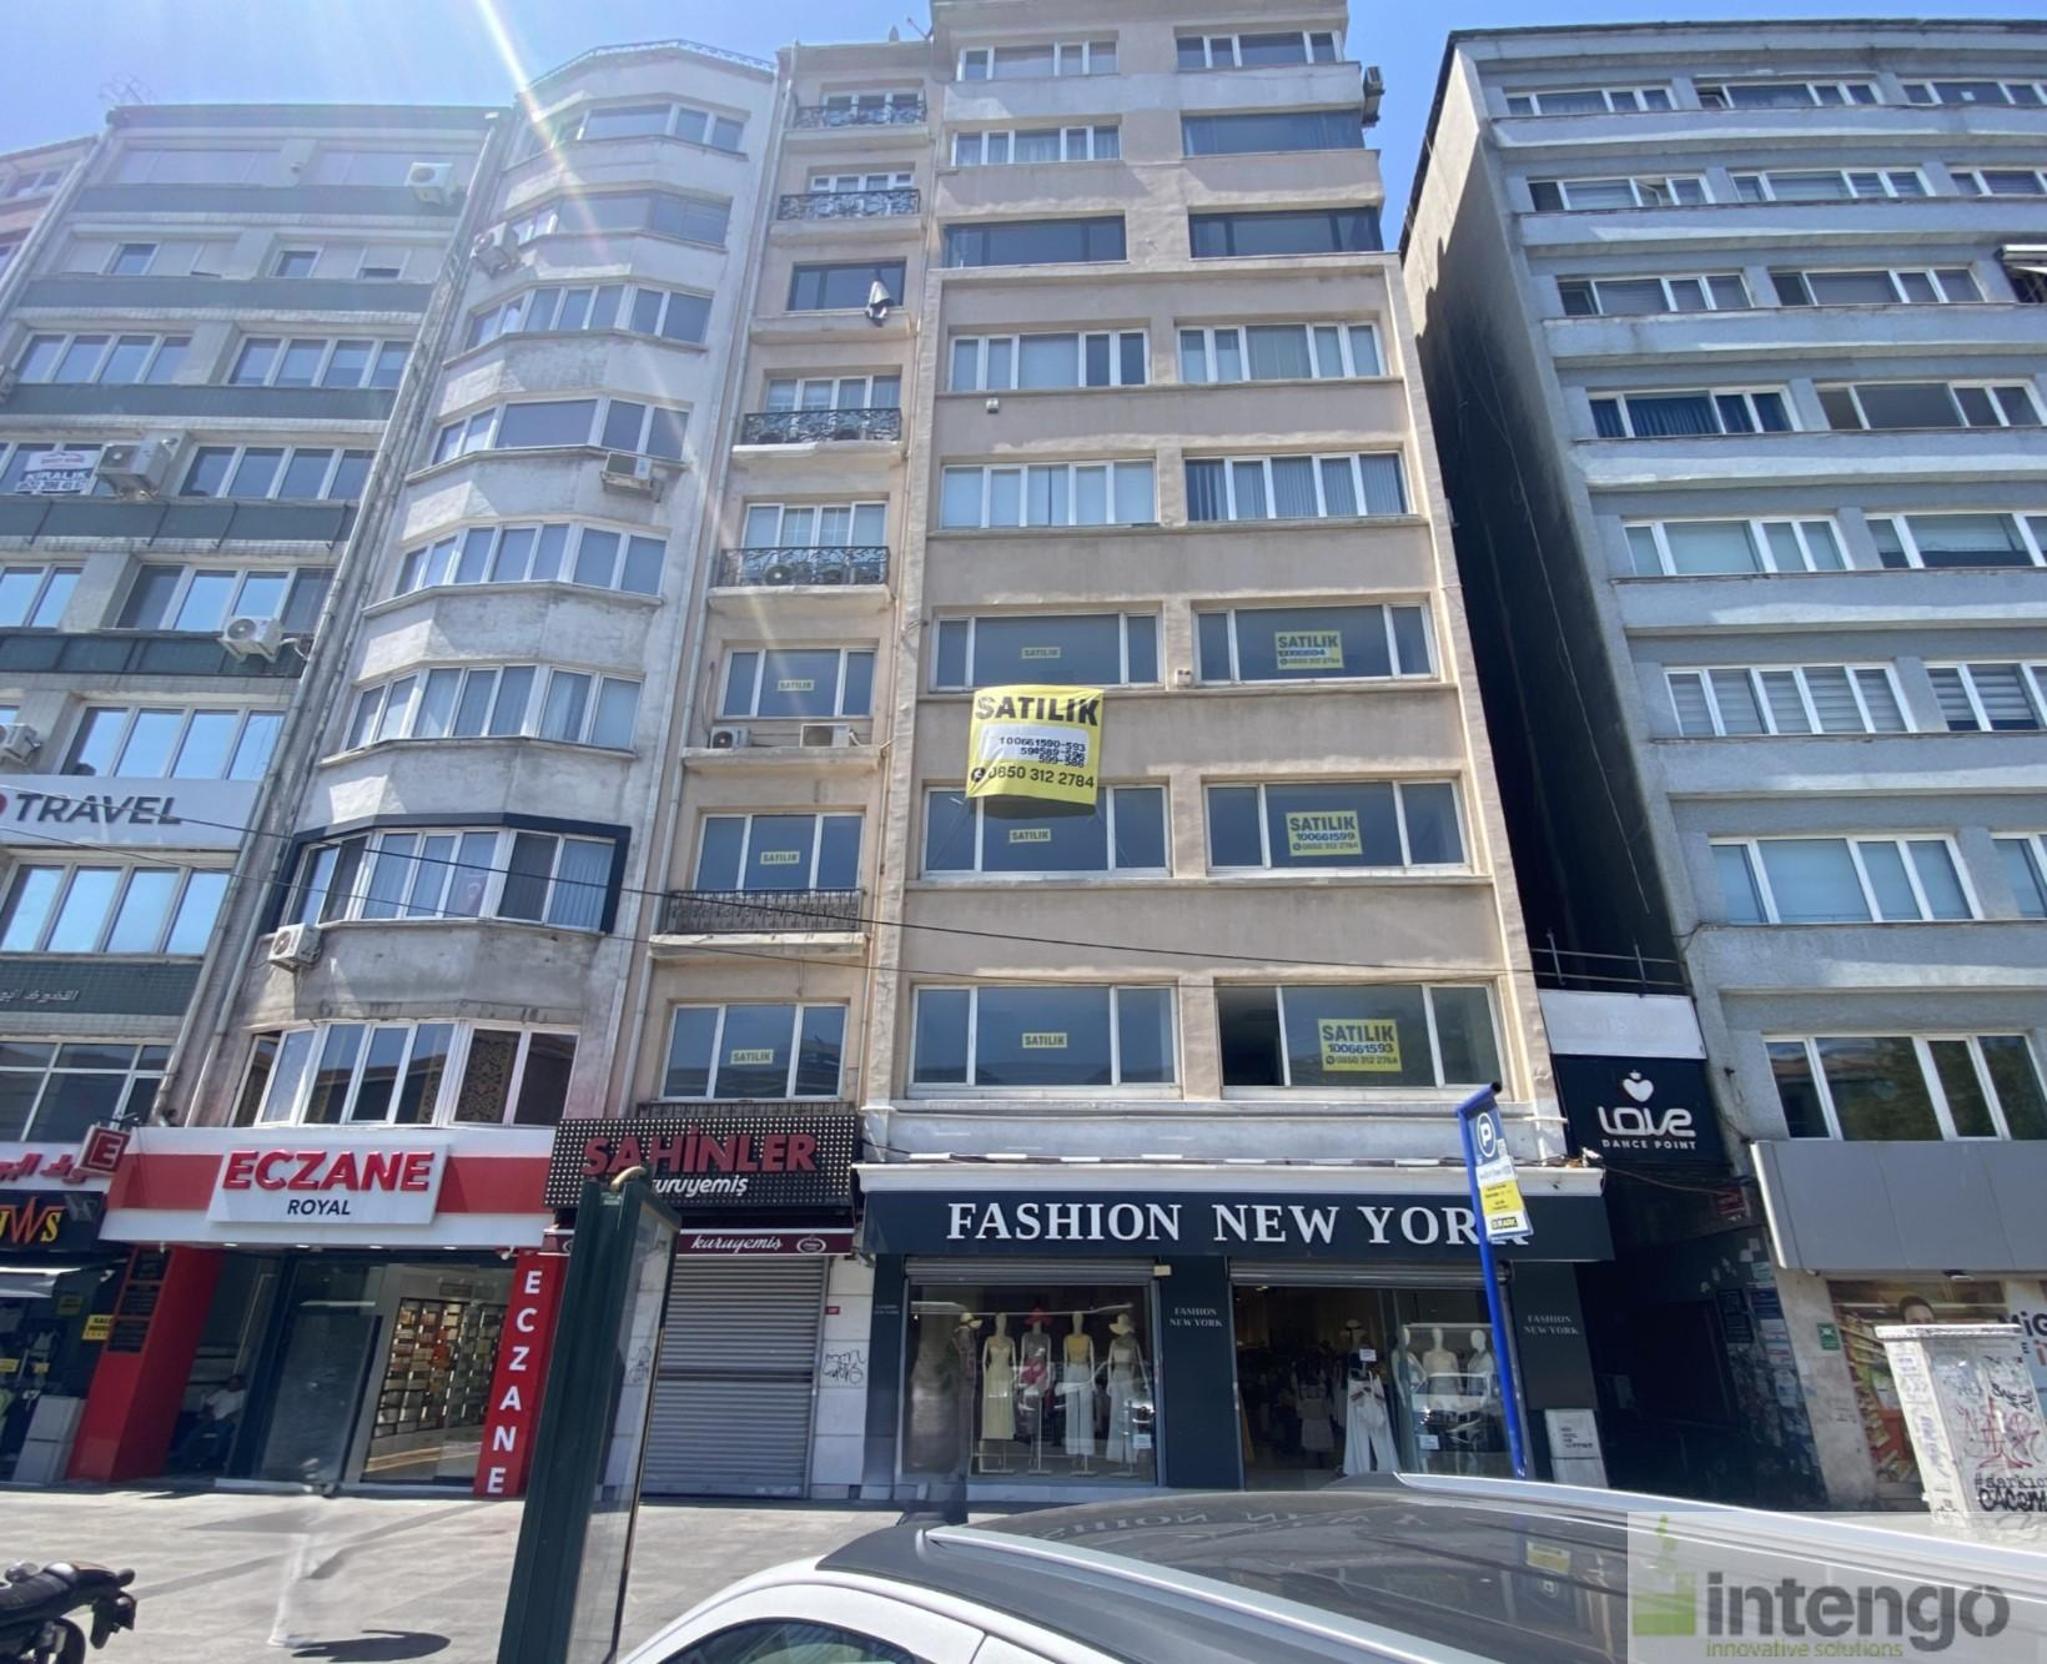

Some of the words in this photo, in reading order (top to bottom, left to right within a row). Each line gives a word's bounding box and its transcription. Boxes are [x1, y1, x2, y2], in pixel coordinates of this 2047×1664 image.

[1278, 635, 1339, 648] SATILIK
[975, 695, 1099, 727] SATILIK
[1030, 769, 1054, 783] 312
[1058, 772, 1095, 788] 2784
[15, 793, 181, 825] TRAVEL
[1289, 816, 1356, 831] SATILIK
[1012, 831, 1049, 840] SATILIK
[1024, 1035, 1065, 1046] SATILIK
[1322, 1025, 1395, 1042] SATILIK
[732, 1051, 771, 1062] SATILIK
[1602, 1139, 1648, 1148] DANCE
[1655, 1140, 1697, 1149] POINT
[221, 1148, 435, 1192] ECZANE
[653, 1177, 749, 1197] uruyemiş
[287, 1199, 351, 1216] ROYAL
[947, 1202, 1182, 1240] FASHION
[1212, 1204, 1340, 1243] NEW
[1357, 1206, 1529, 1245] YOR
[1174, 1307, 1217, 1315] FASHION
[1527, 1315, 1572, 1323] FASHION
[1169, 1318, 1193, 1327] NEW
[1195, 1319, 1224, 1327] YORK
[487, 1270, 542, 1494] ECZANE
